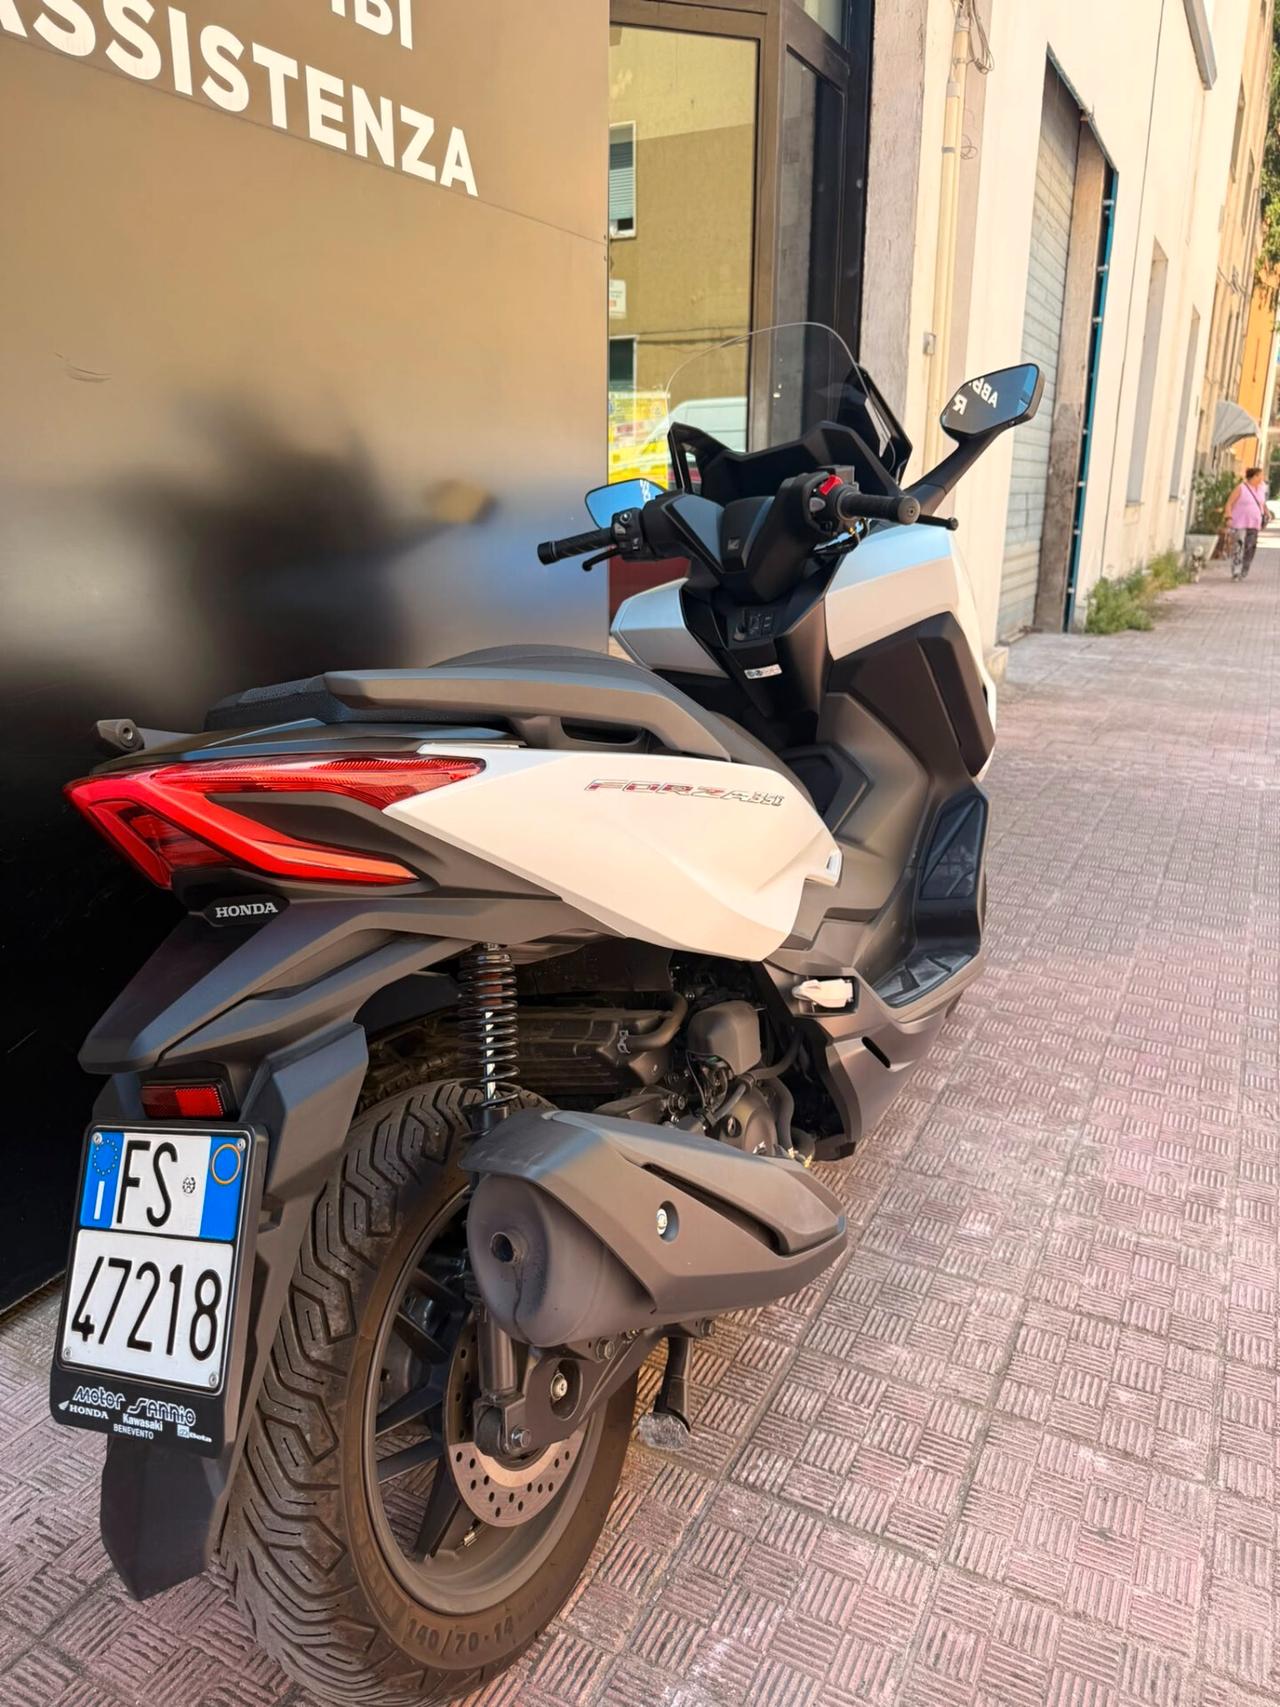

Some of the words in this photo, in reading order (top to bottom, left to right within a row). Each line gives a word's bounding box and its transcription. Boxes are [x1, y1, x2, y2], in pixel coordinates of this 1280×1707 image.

[215, 902, 278, 918] HONDA
[116, 1139, 178, 1227] FS
[71, 1256, 222, 1361] 47218
[69, 1404, 109, 1420] HONDA
[113, 1423, 154, 1440] BENEVENTO
[122, 1413, 163, 1432] Kawasaki
